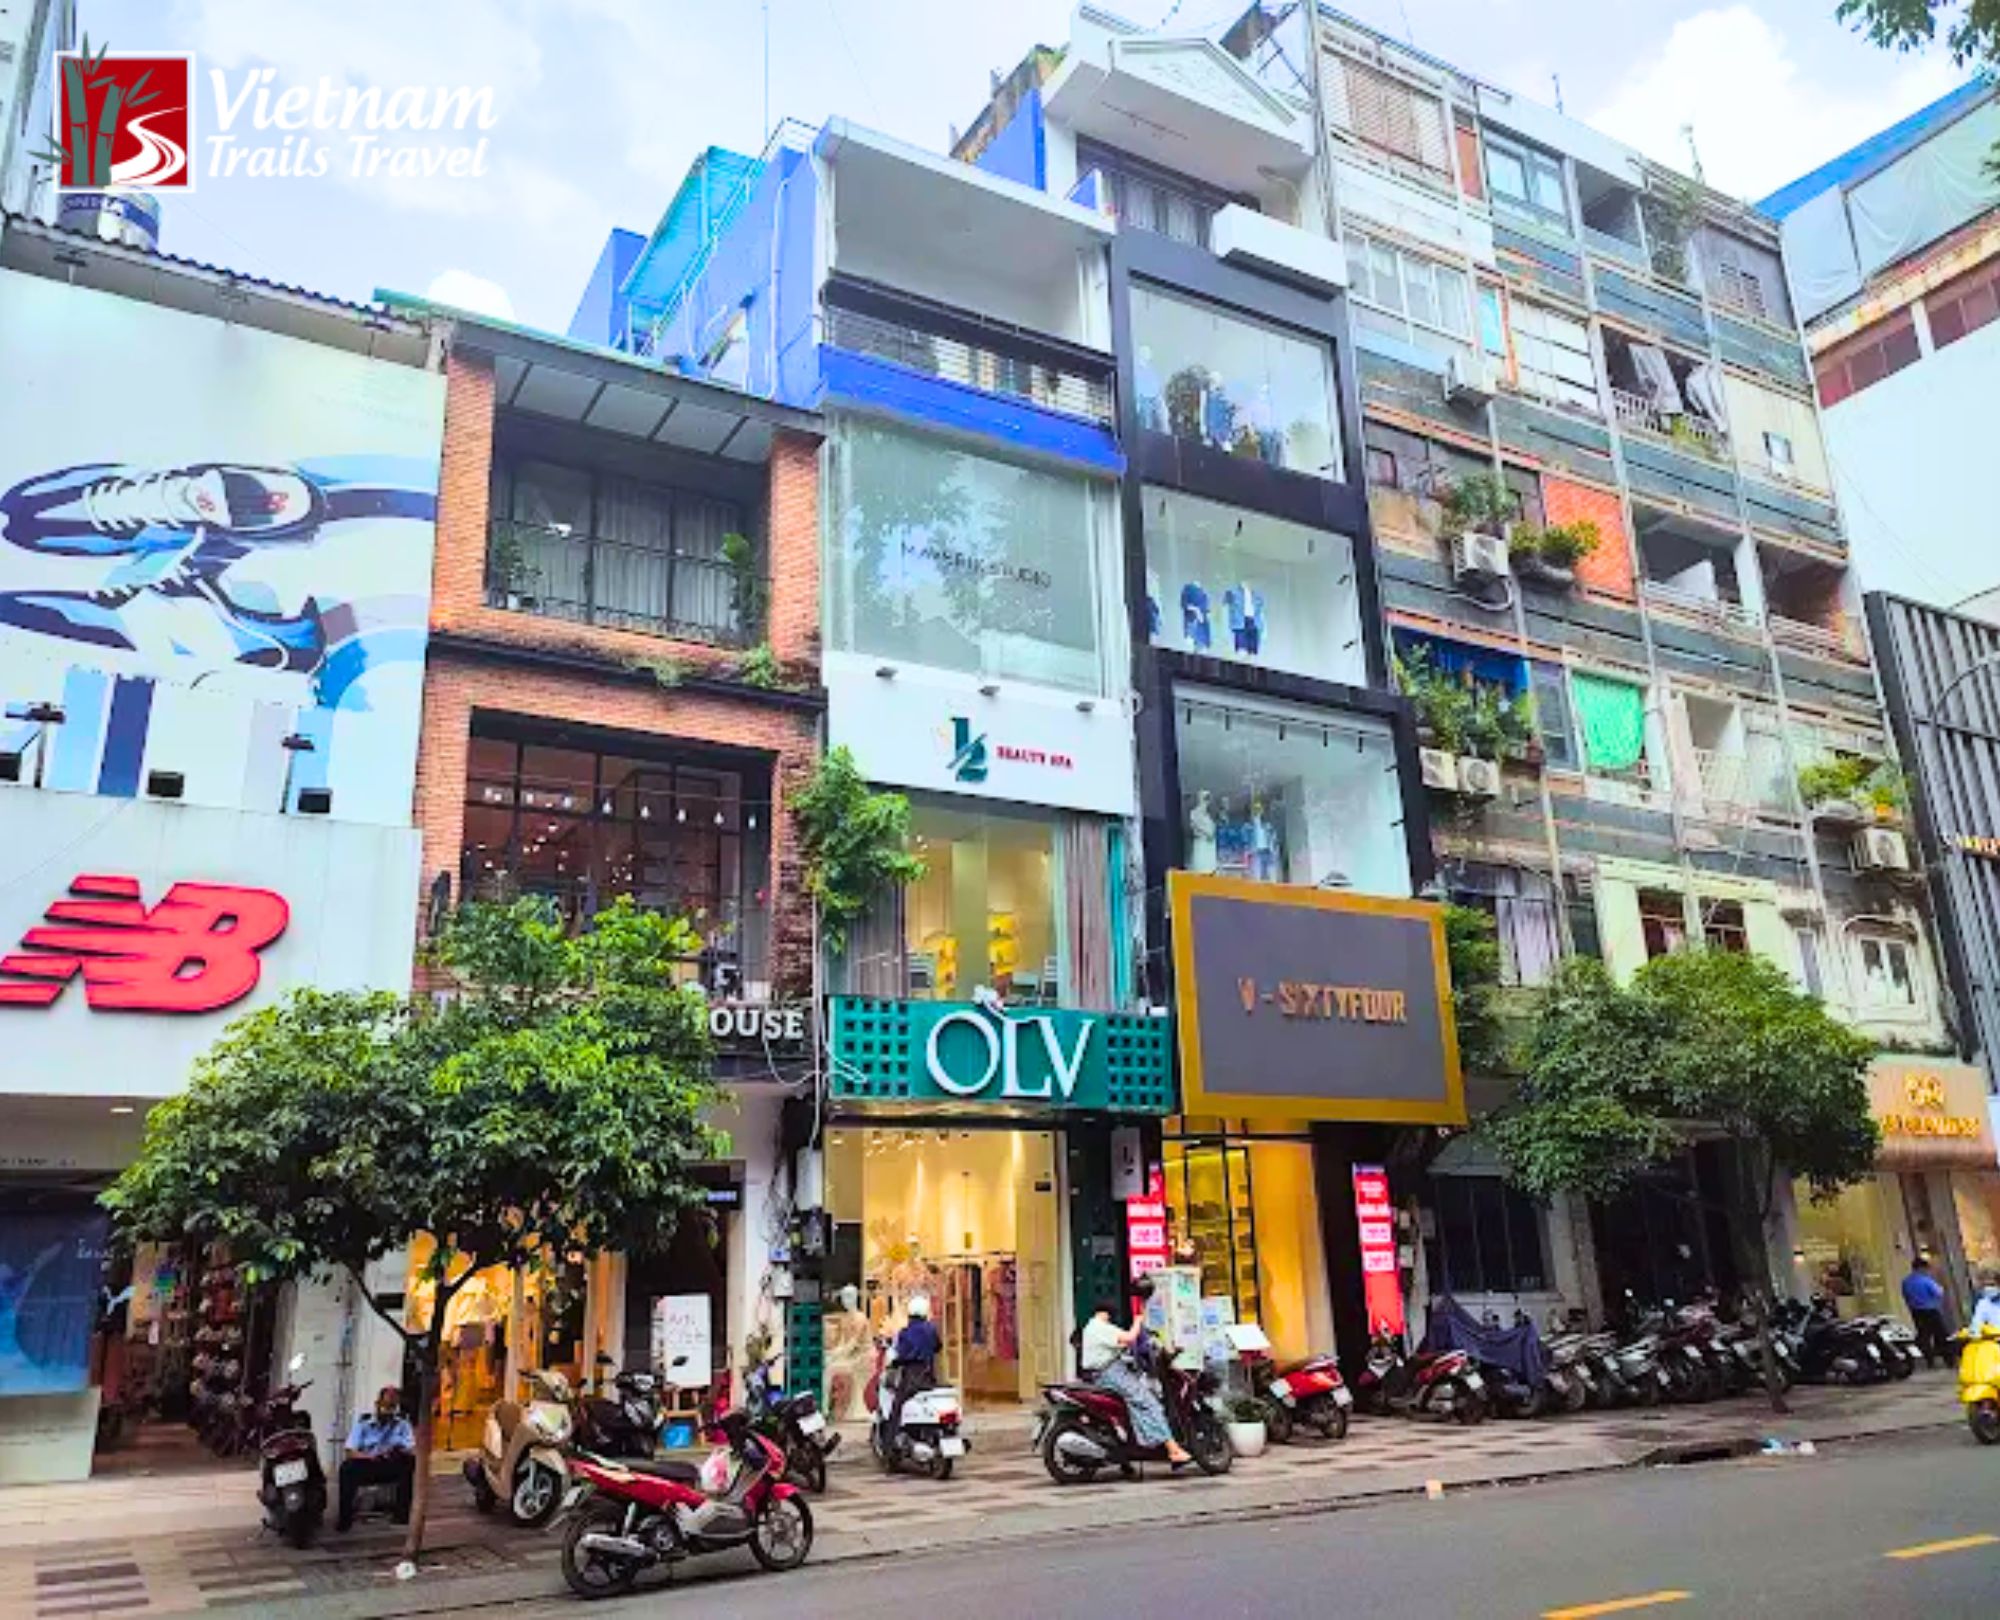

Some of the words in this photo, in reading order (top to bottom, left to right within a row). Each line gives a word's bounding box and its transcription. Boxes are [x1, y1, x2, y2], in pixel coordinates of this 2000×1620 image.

[1238, 977, 1255, 1012] V
[1279, 980, 1407, 1021] SIXTYFOUR
[709, 1006, 804, 1040] OUSE
[925, 1010, 1096, 1099] OLV
